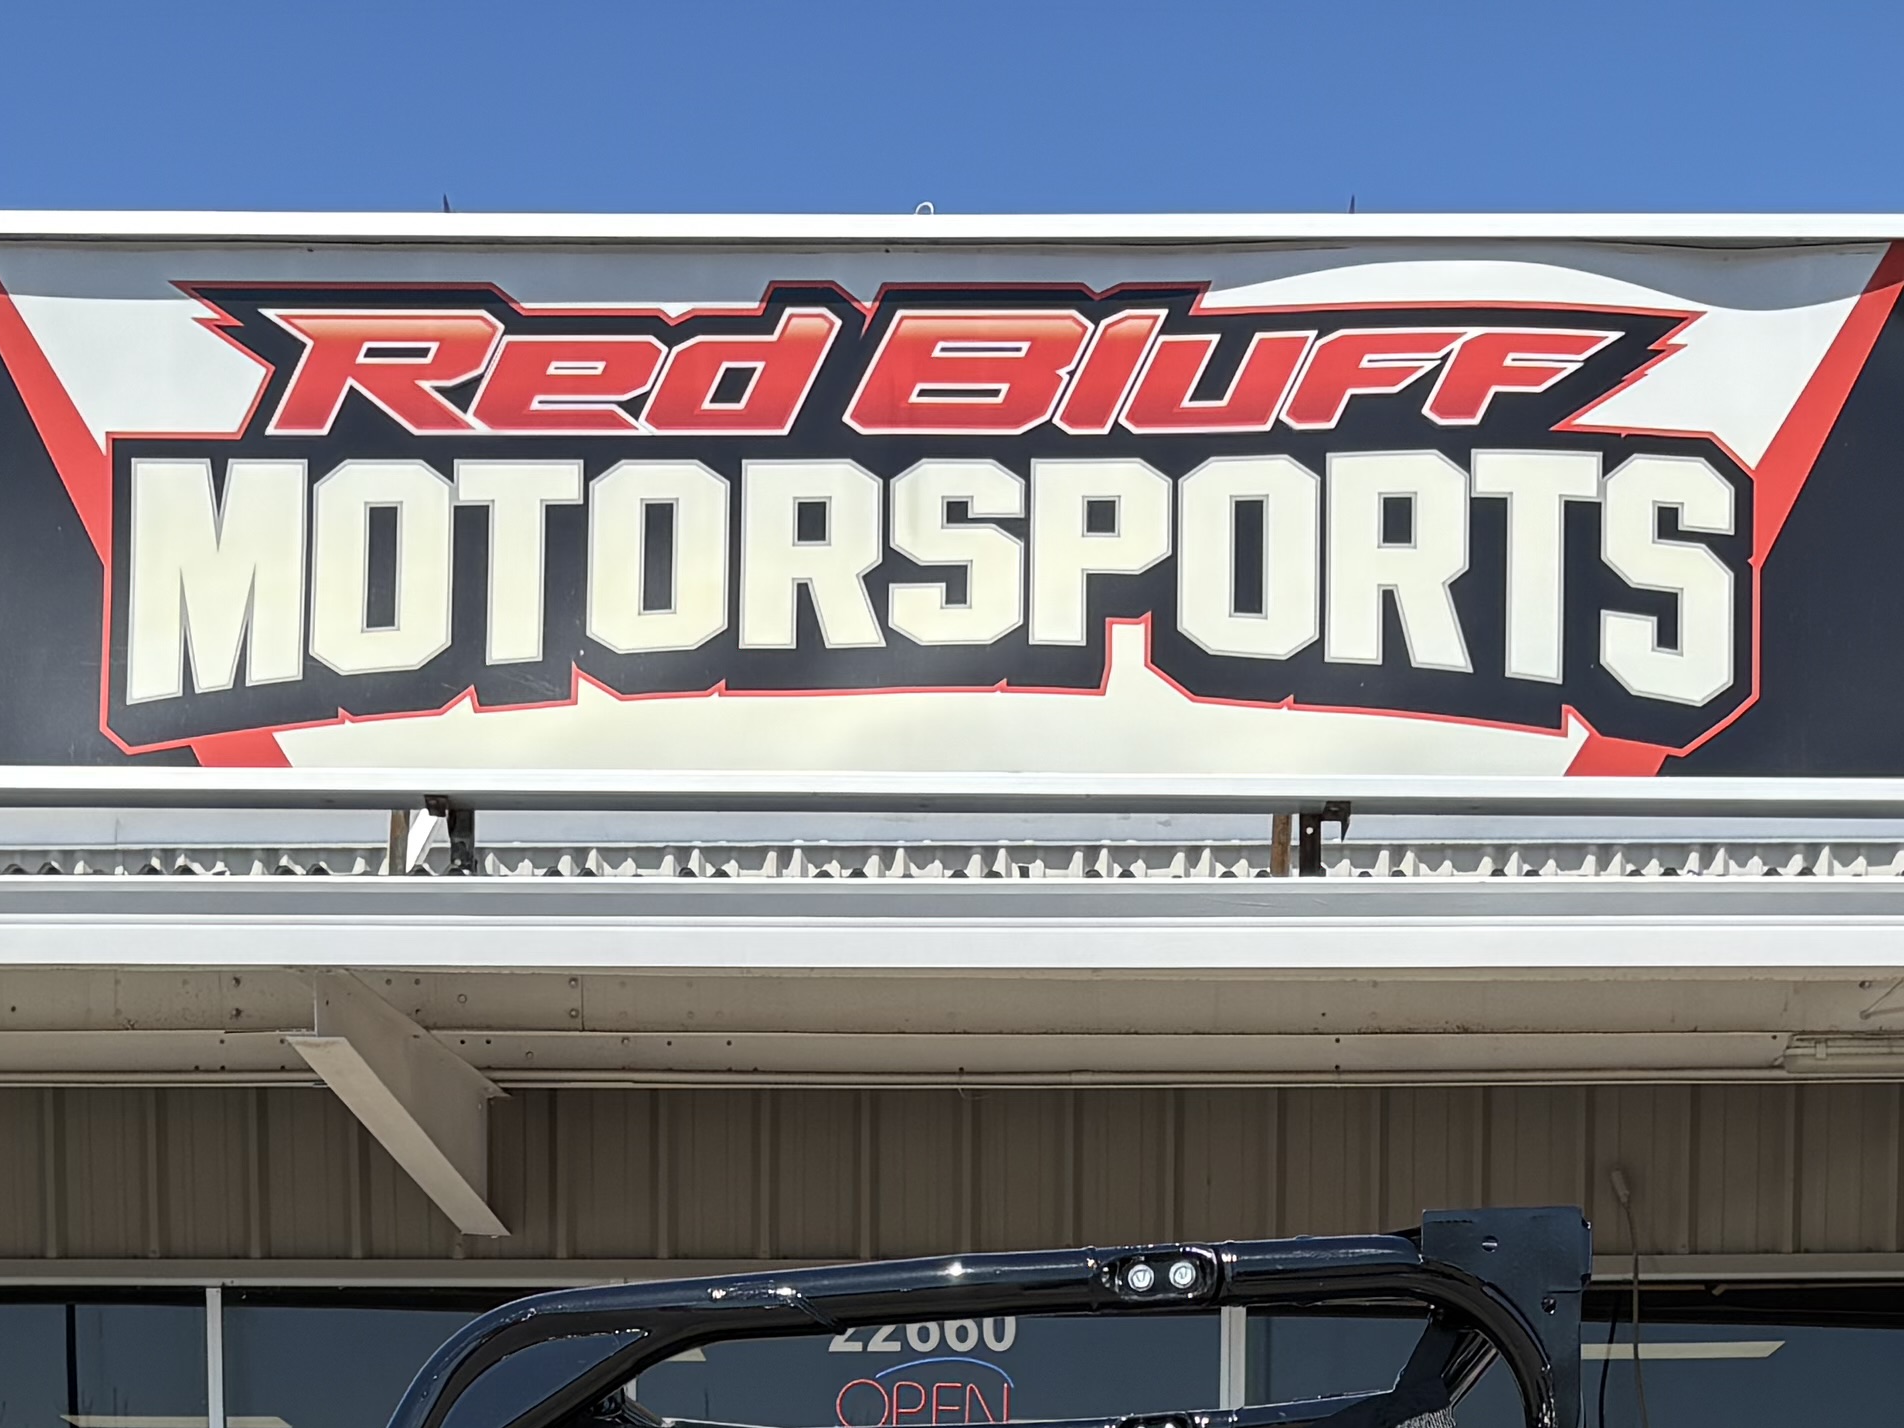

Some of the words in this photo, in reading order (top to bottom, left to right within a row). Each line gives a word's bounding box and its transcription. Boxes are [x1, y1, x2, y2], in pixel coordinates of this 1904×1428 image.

[264, 304, 839, 438] Red
[845, 306, 1632, 438] Bluff
[126, 449, 1737, 710] MOTORSPORTS
[836, 1379, 1010, 1428] OPEN
